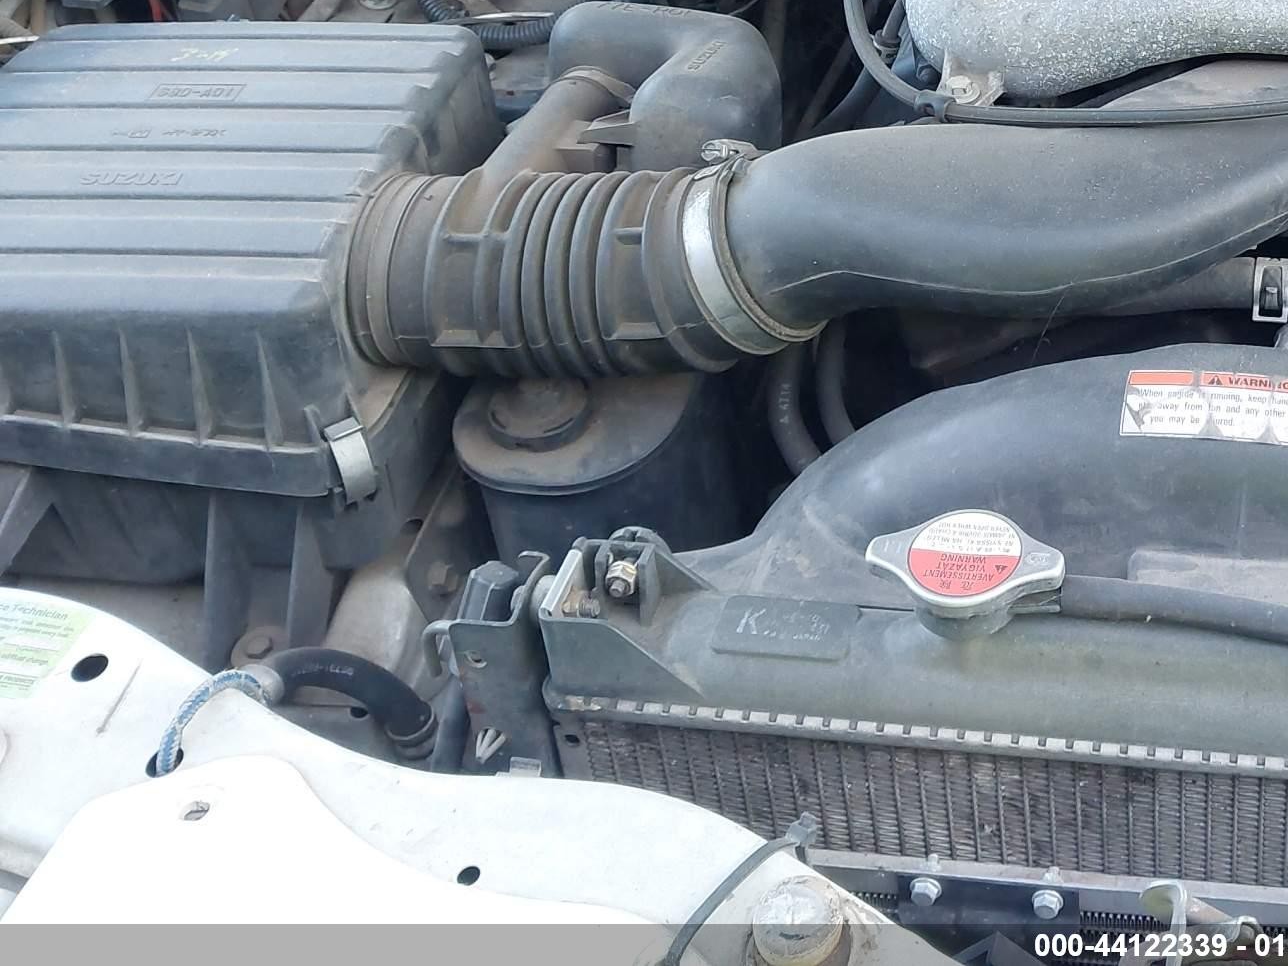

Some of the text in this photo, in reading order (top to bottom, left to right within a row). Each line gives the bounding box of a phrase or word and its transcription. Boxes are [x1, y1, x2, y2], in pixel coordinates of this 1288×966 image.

[80, 172, 184, 185] SUZUKI
[1184, 401, 1203, 410] from
[1225, 403, 1240, 413] and
[1245, 407, 1259, 417] any
[1264, 408, 1286, 418] other
[1168, 415, 1186, 426] may
[940, 554, 986, 563] WARNING
[923, 569, 995, 581] AVERTISSEMENT
[14, 604, 68, 620] Technician
